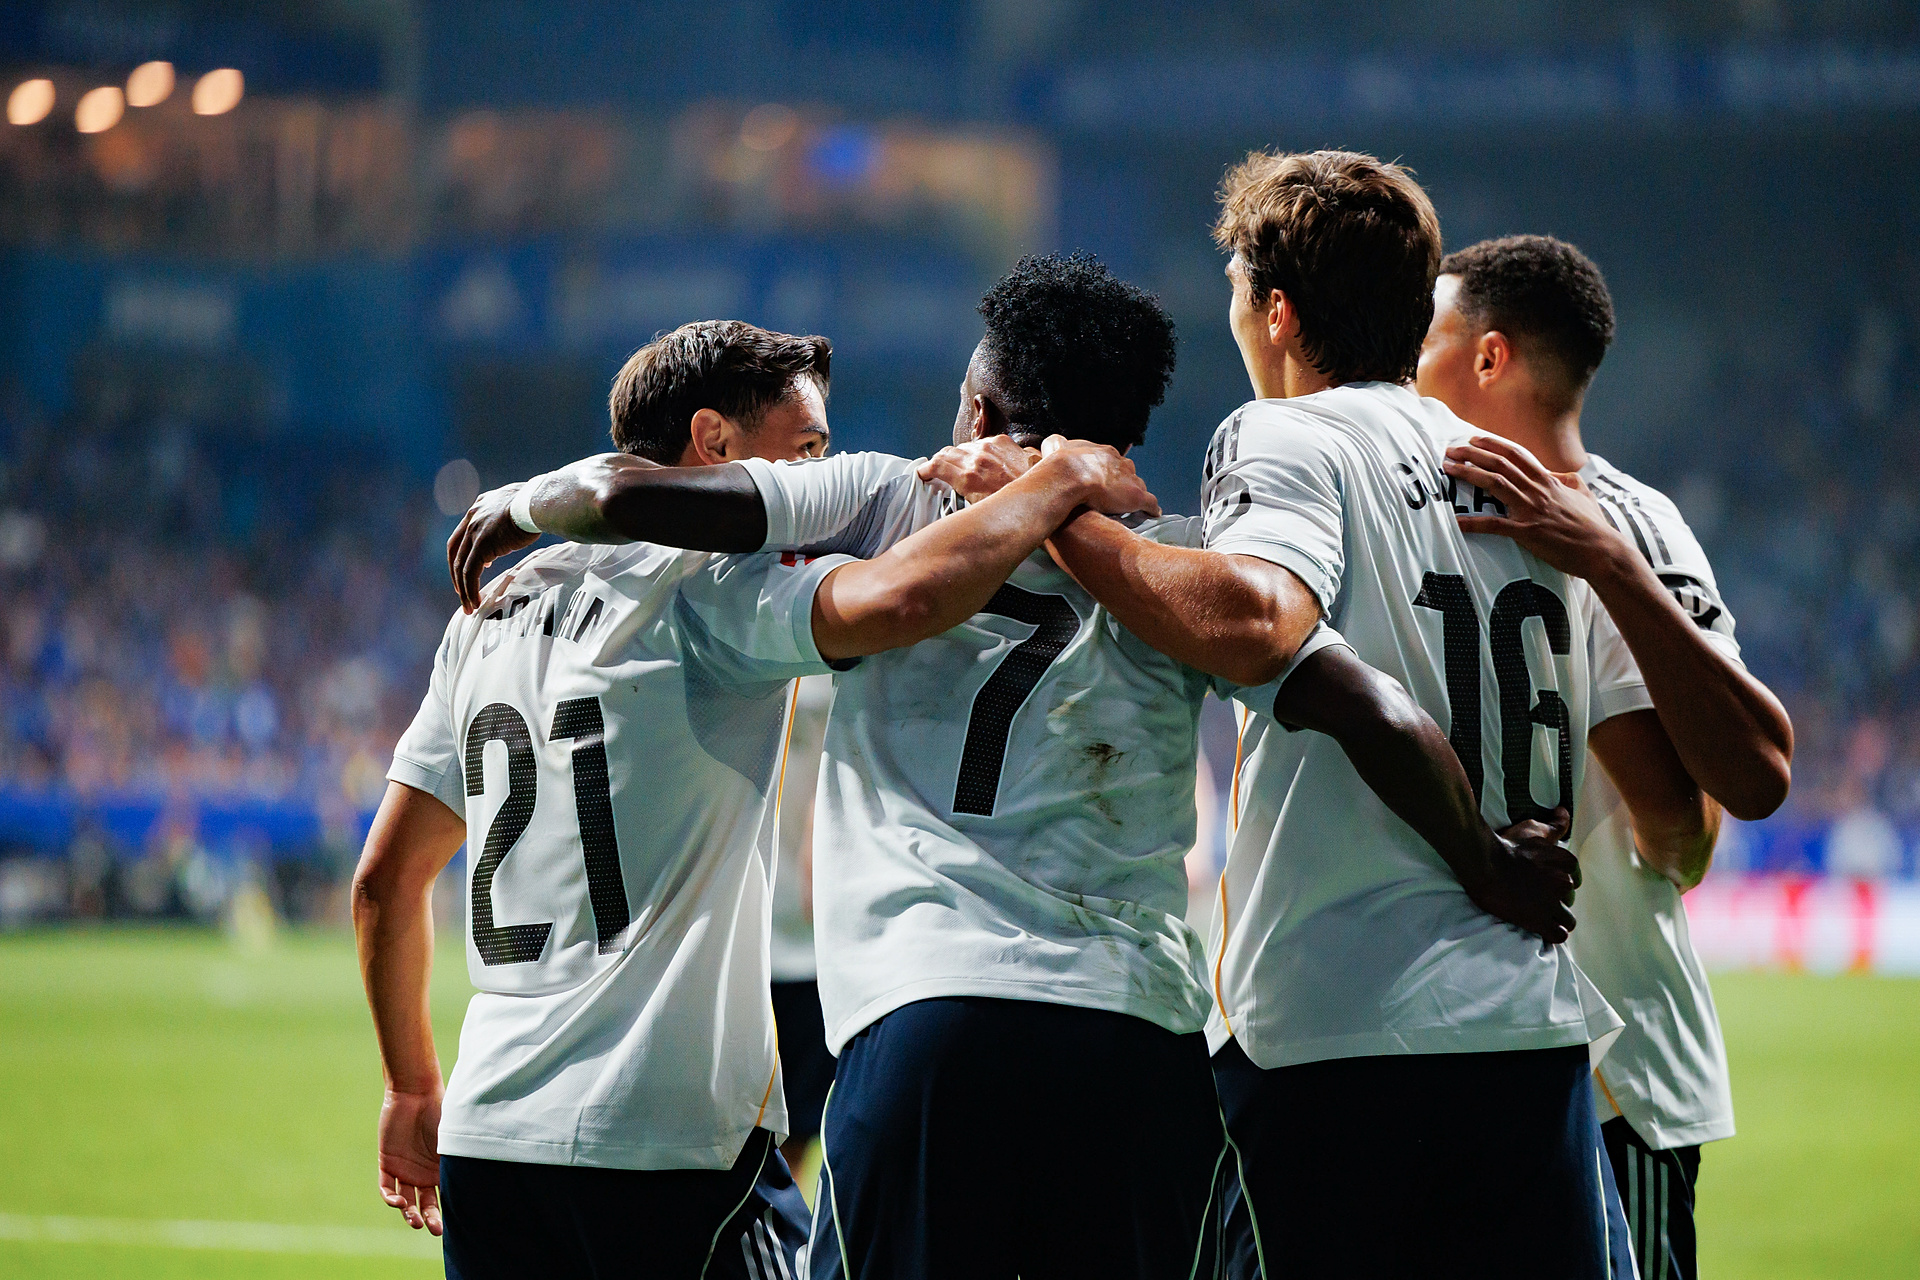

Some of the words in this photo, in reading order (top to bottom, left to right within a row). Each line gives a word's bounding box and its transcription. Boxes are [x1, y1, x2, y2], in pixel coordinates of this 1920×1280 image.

[464, 695, 632, 967] 21
[951, 580, 1083, 819] 7
[1411, 570, 1574, 842] 16
